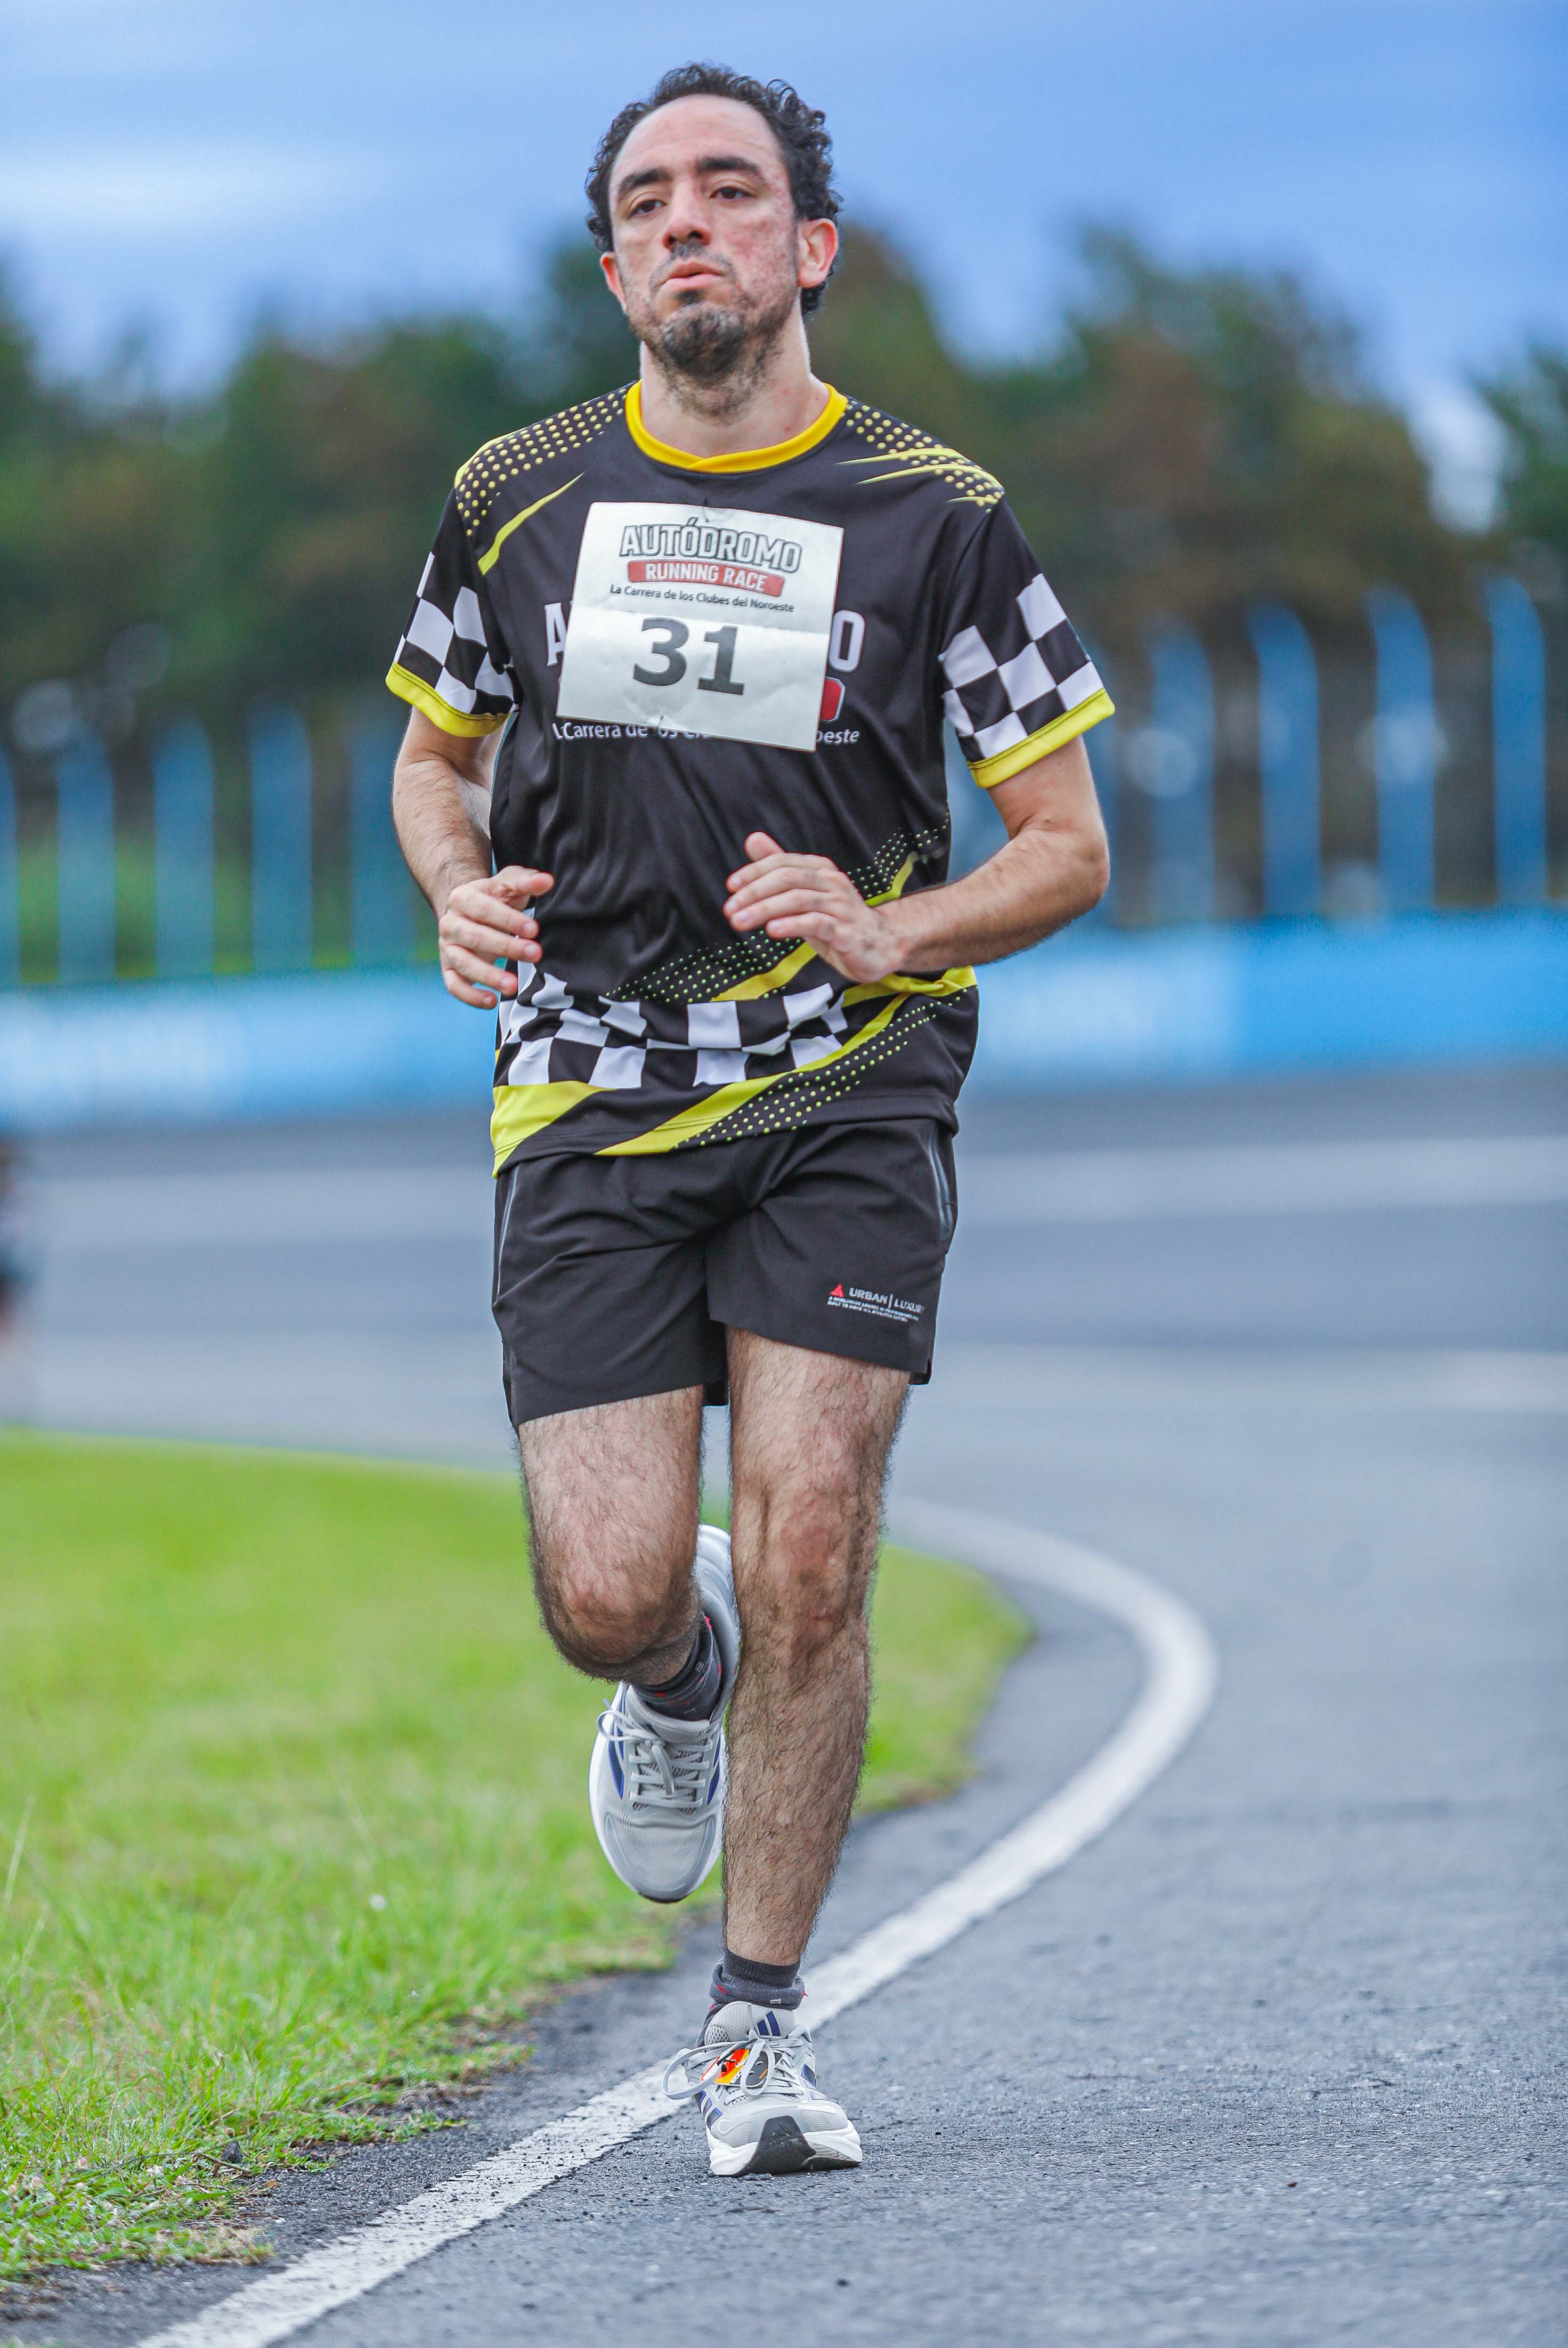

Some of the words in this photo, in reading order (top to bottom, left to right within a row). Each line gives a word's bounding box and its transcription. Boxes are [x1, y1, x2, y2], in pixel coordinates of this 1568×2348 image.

[619, 517, 802, 573] AUTÓDROMO
[645, 563, 719, 583] RUNNING
[723, 567, 767, 592] RACE
[610, 584, 622, 594] La
[624, 586, 661, 598] Carrera
[664, 589, 677, 599] de
[679, 590, 694, 601] los
[696, 592, 729, 605] Clubes
[733, 596, 748, 607] del
[750, 598, 794, 612] Noroeste
[632, 617, 745, 696] 31
[563, 722, 622, 741] Carrera
[849, 1287, 888, 1304] URBAN
